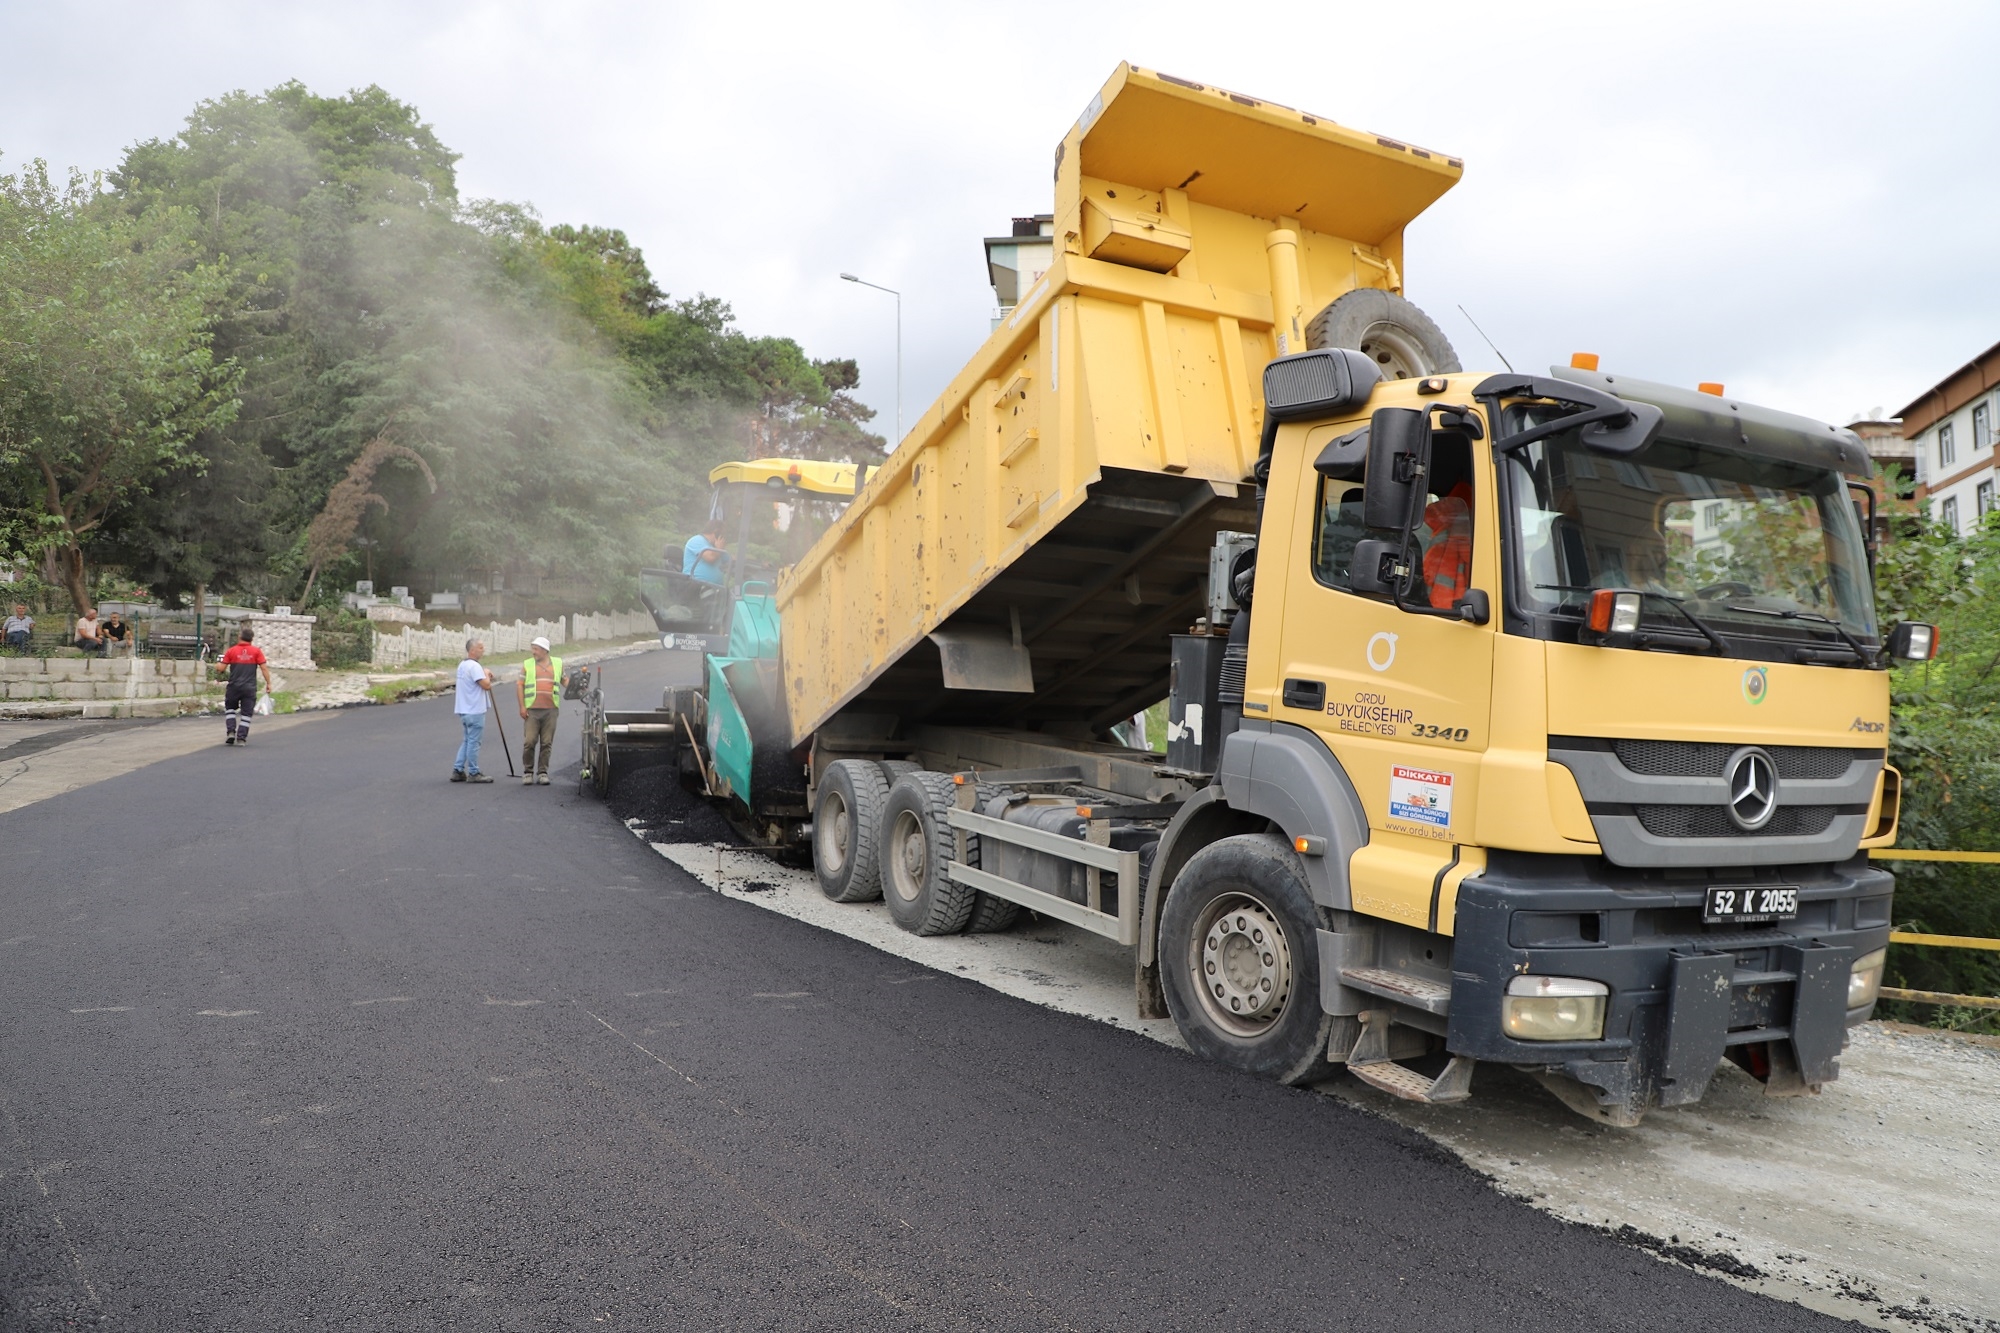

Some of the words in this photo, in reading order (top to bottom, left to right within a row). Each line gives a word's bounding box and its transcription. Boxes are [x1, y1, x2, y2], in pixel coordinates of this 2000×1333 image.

[1355, 692, 1386, 705] ORDU
[1326, 701, 1413, 724] BÜYÜKŞEHİR
[1340, 719, 1397, 736] BELEDİYESİ
[1411, 723, 1470, 742] 3340
[1398, 769, 1440, 783] DİKKAT
[1401, 804, 1423, 813] ALANDA
[1385, 822, 1456, 841] www.ordu.bel.tr
[1714, 890, 1736, 914] 52
[1743, 889, 1756, 913] K
[1759, 889, 1797, 913] 2055
